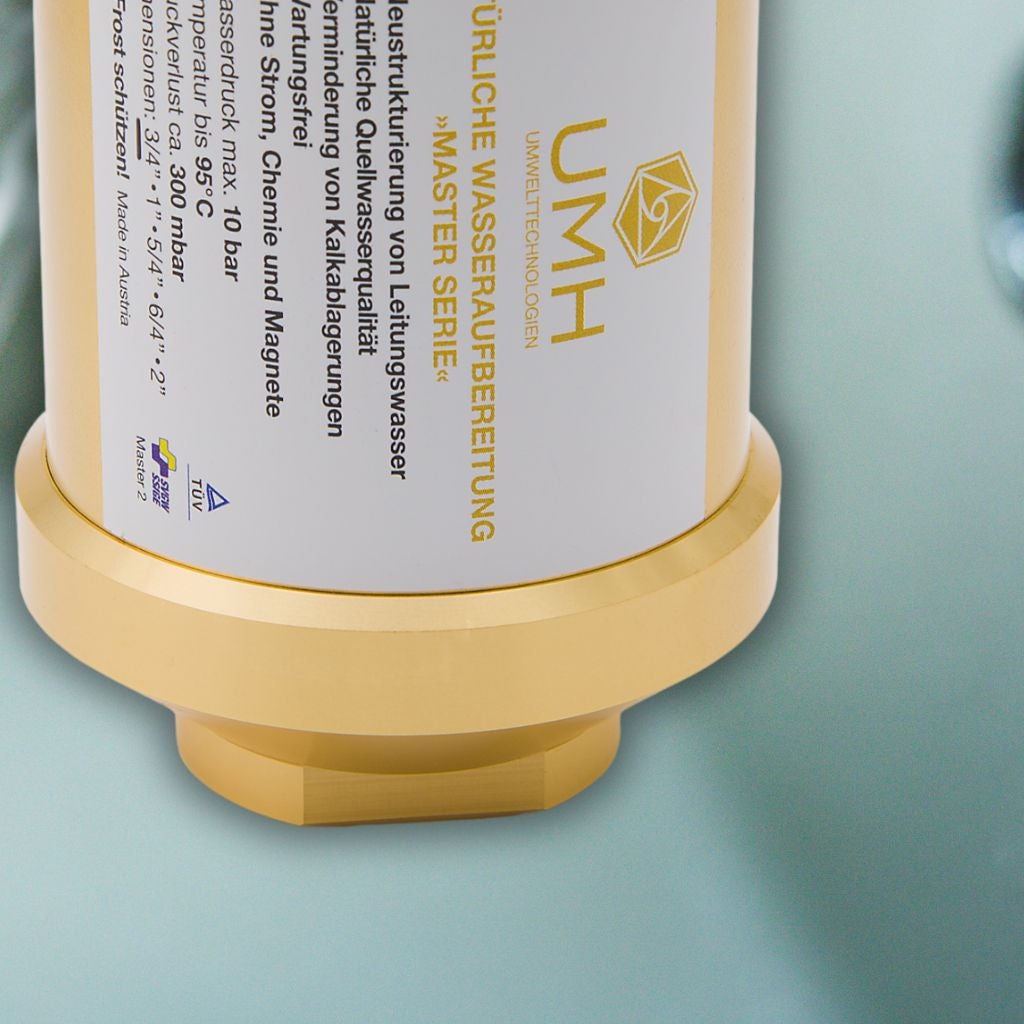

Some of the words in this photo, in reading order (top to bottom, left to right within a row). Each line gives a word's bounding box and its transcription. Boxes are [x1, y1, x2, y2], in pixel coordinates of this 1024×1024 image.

[113, 62, 130, 180] schützen!
[257, 56, 281, 140] Strom,
[168, 122, 181, 156] ca.
[193, 113, 212, 148] bis
[169, 164, 187, 209] 300
[195, 156, 214, 218] 95°C
[222, 139, 237, 195] max.
[261, 150, 282, 246] Chemie
[325, 166, 340, 211] von
[432, 115, 458, 265] »MASTER
[115, 190, 129, 242] Made
[223, 205, 242, 233] 10
[353, 119, 378, 356] Quellwasserqualität
[525, 130, 540, 349] UMWELTTECHNOLOGIEN
[551, 118, 607, 344] UMH
[119, 245, 129, 257] in
[170, 216, 188, 282] mbar
[224, 239, 242, 282] bar
[263, 254, 283, 302] und
[389, 229, 405, 275] von
[118, 260, 130, 326] Austria
[322, 218, 346, 437] Kalkablagerungen
[432, 275, 458, 382] SERIE«
[470, 159, 496, 543] WASSERAUFBEREITUNG
[261, 309, 284, 418] Magnete
[385, 283, 410, 480] Leitungswasser
[136, 435, 146, 488] Master
[137, 490, 147, 502] 2
[191, 479, 205, 512] TÜV
